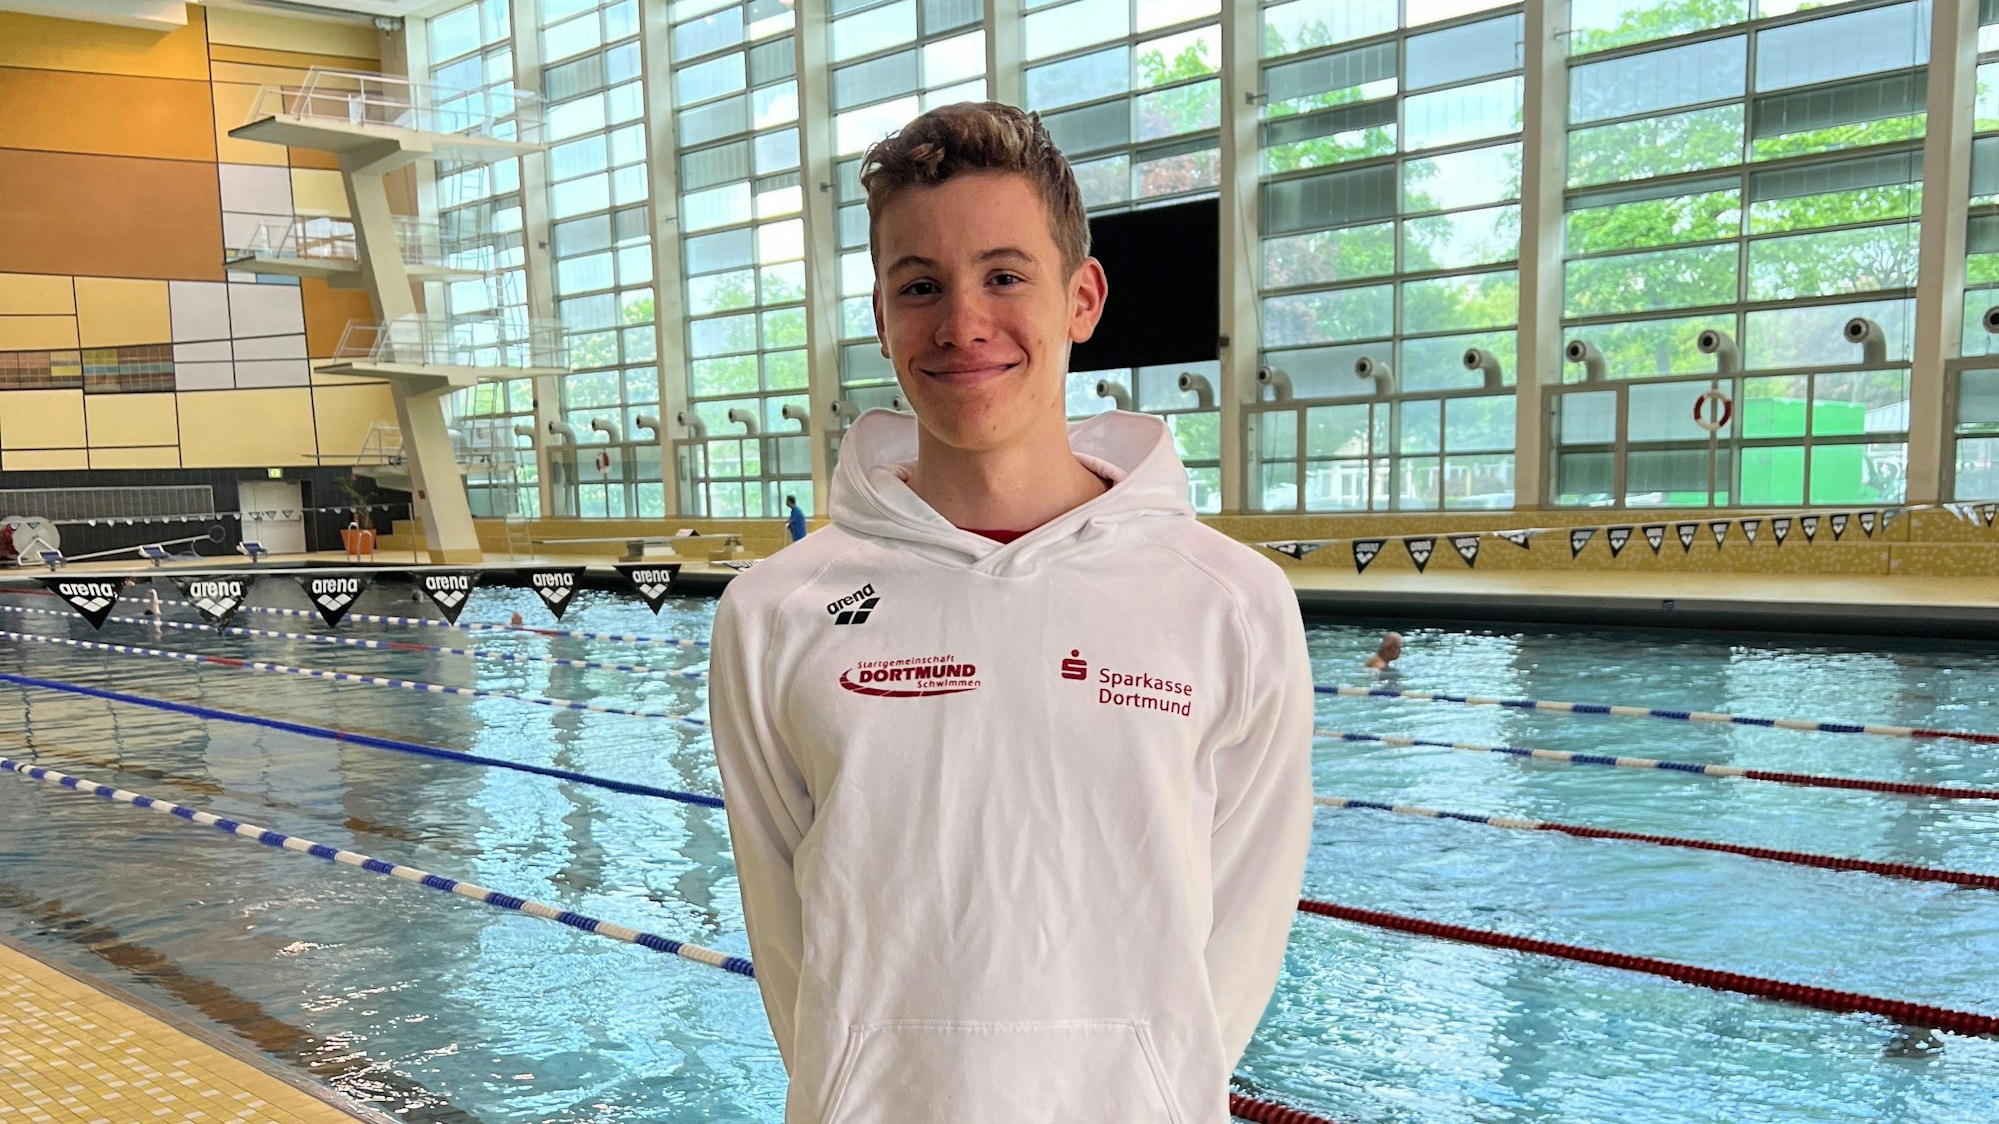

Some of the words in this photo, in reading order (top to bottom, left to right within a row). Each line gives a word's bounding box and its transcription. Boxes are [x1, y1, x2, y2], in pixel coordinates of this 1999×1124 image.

[426, 576, 469, 590] arena
[533, 573, 574, 587] arena
[632, 570, 671, 583] arena
[59, 583, 115, 597] arena
[190, 581, 242, 598] arena
[312, 578, 358, 594] arena
[827, 583, 875, 615] arena
[857, 654, 955, 669] Startgemeinschaft
[859, 664, 976, 683] DORTMUND
[917, 680, 981, 689] Schwimmen
[1099, 668, 1192, 696] Sparkasse
[1098, 688, 1191, 716] Dortmund
